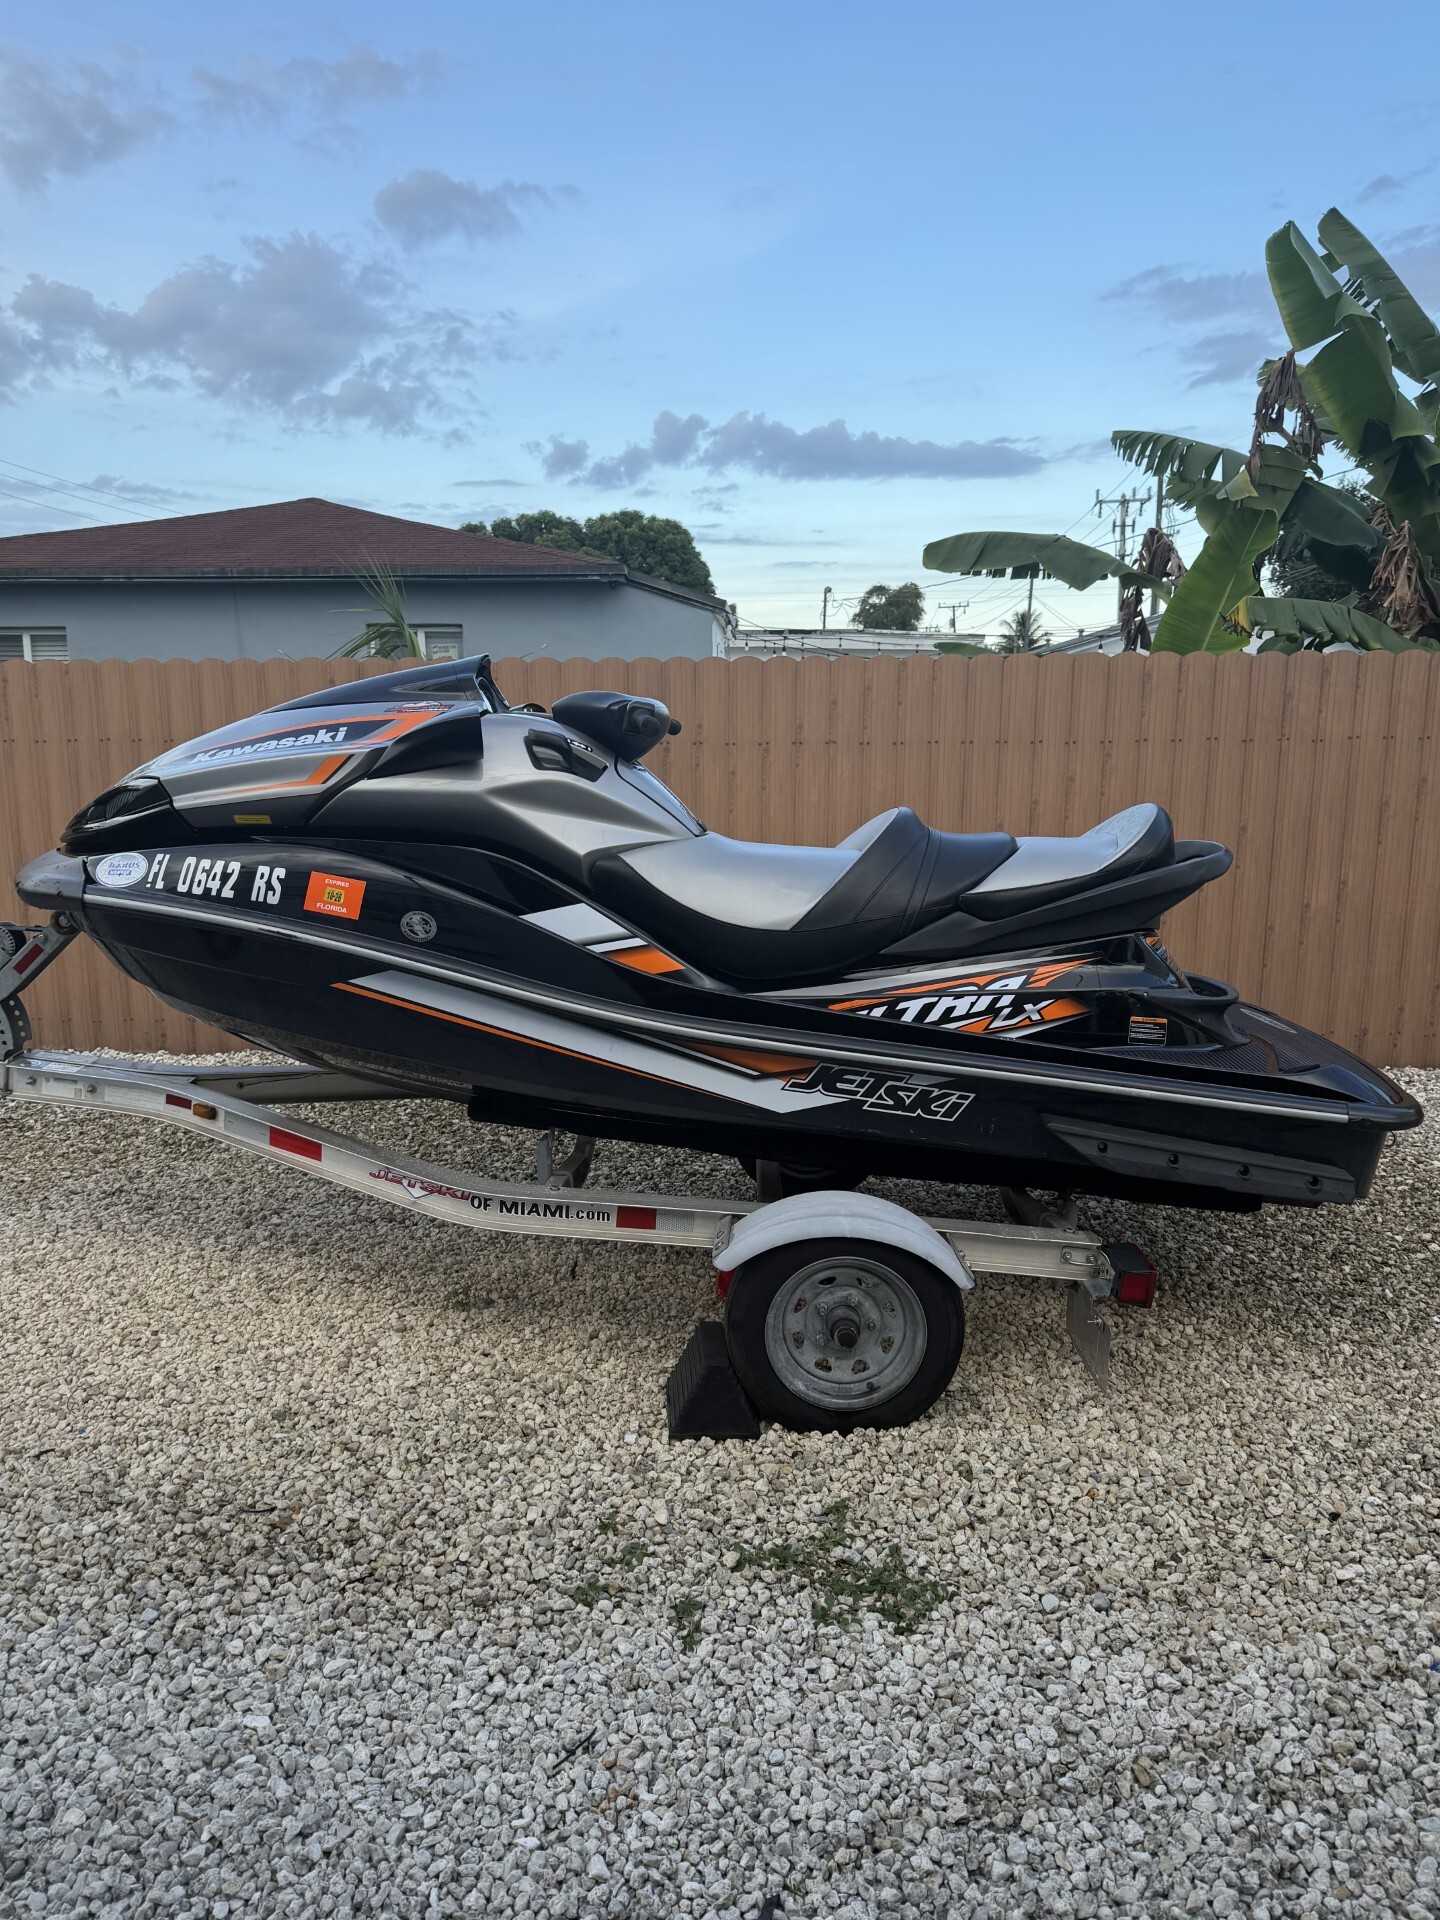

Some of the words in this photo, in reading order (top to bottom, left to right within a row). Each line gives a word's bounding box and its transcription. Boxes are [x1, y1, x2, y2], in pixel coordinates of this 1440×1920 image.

[188, 726, 348, 764] Kawasaki
[146, 853, 170, 889] FL
[177, 856, 241, 898] 0642
[251, 865, 286, 905] RS
[325, 878, 350, 888] EXPIRES
[316, 902, 347, 914] FLORIDA
[471, 1195, 493, 1211] OF
[500, 1200, 611, 1222] MIAMI.com
